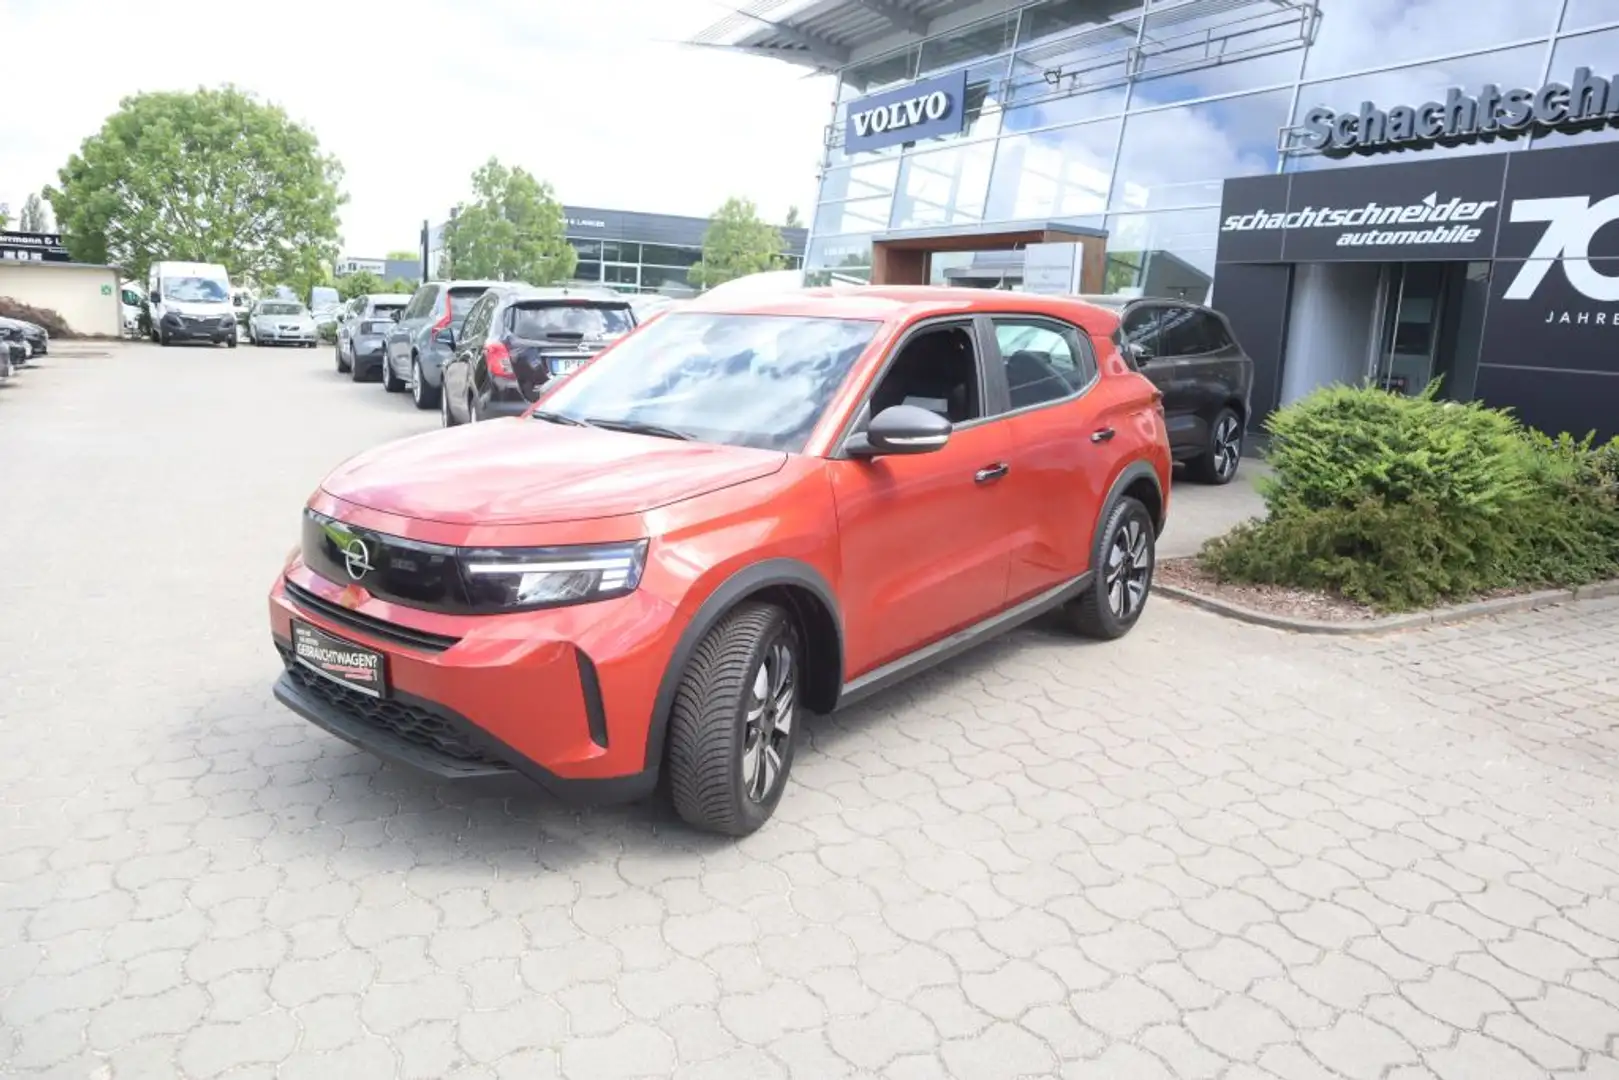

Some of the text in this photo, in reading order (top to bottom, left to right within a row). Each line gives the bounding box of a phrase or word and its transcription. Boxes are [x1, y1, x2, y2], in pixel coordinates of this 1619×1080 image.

[851, 91, 947, 136] VOLVO
[1222, 192, 1498, 231] schachtschneider
[1336, 224, 1482, 247] automobile
[296, 643, 378, 668] GEBRAUCHTWAGEN?
